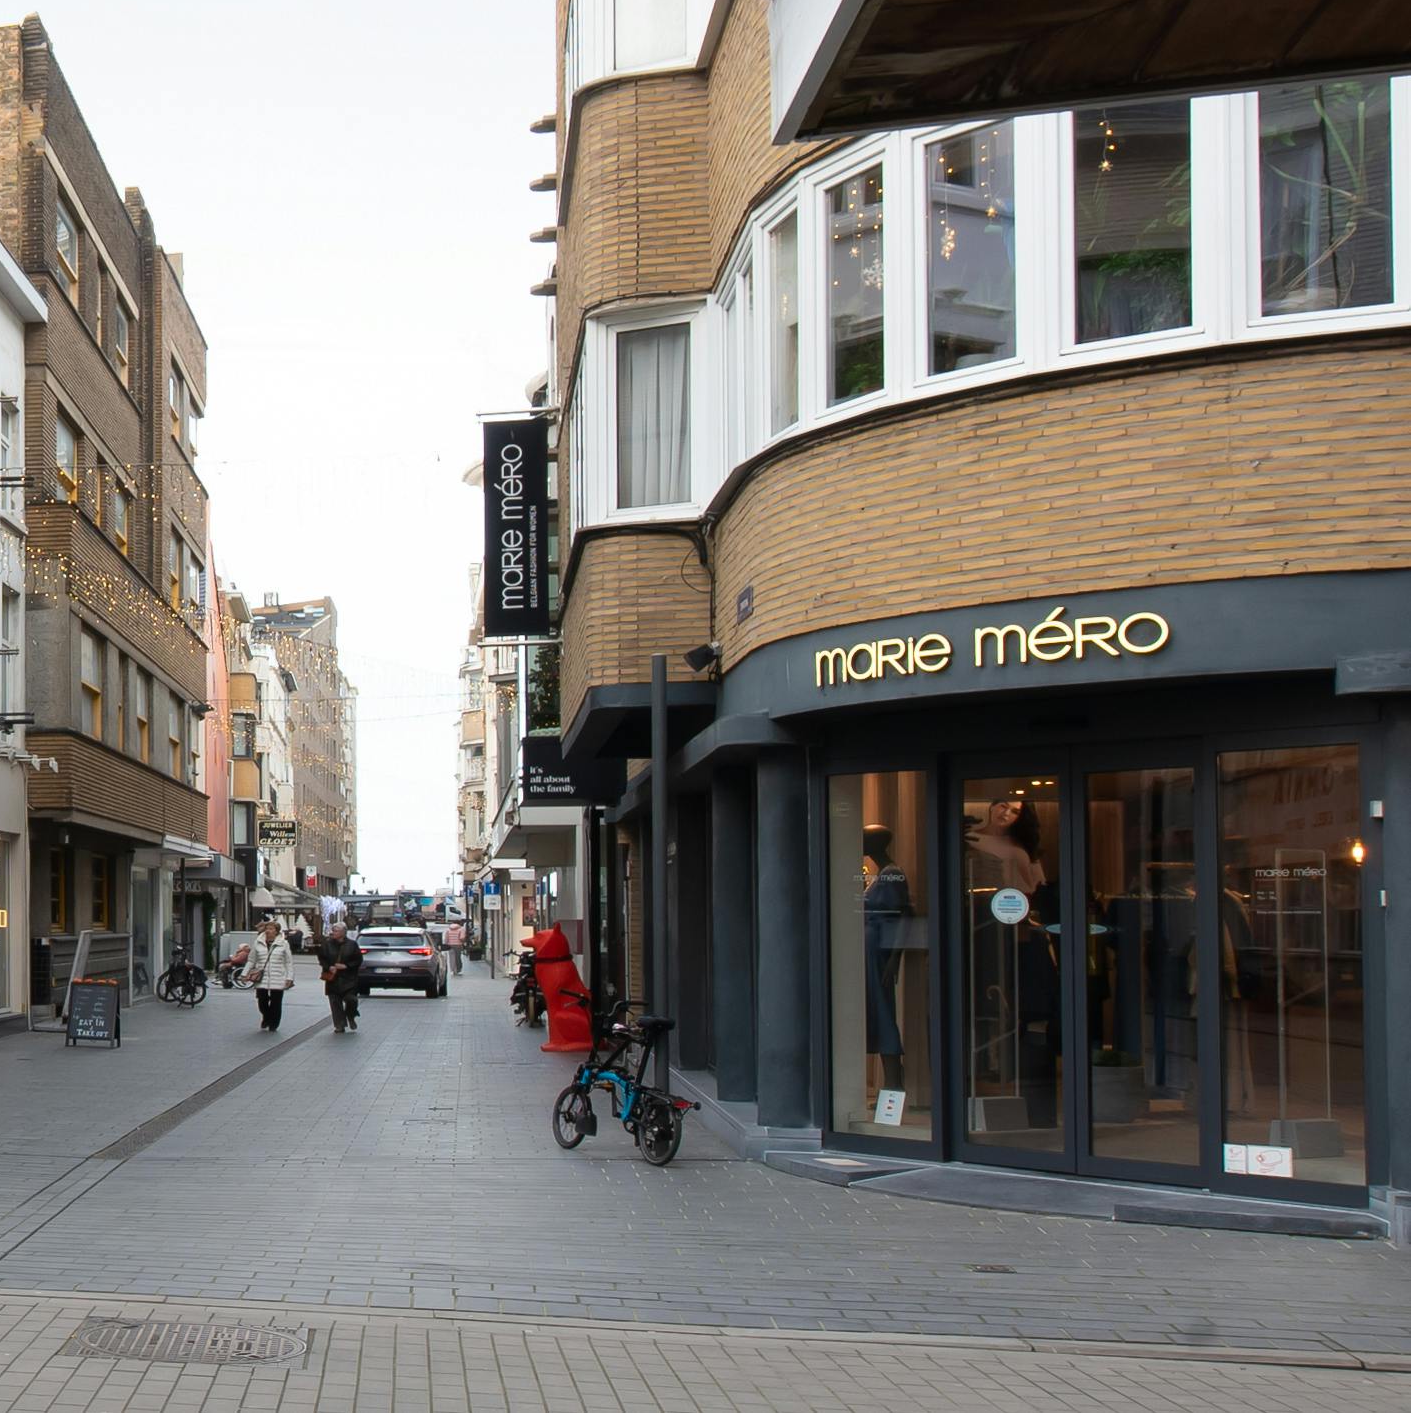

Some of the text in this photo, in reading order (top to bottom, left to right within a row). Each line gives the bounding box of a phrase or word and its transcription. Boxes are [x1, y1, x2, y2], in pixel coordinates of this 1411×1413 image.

[529, 505, 538, 608] BELGIAN FASHION FOR WOMEN
[543, 775, 570, 783] about
[530, 784, 576, 794] the family
